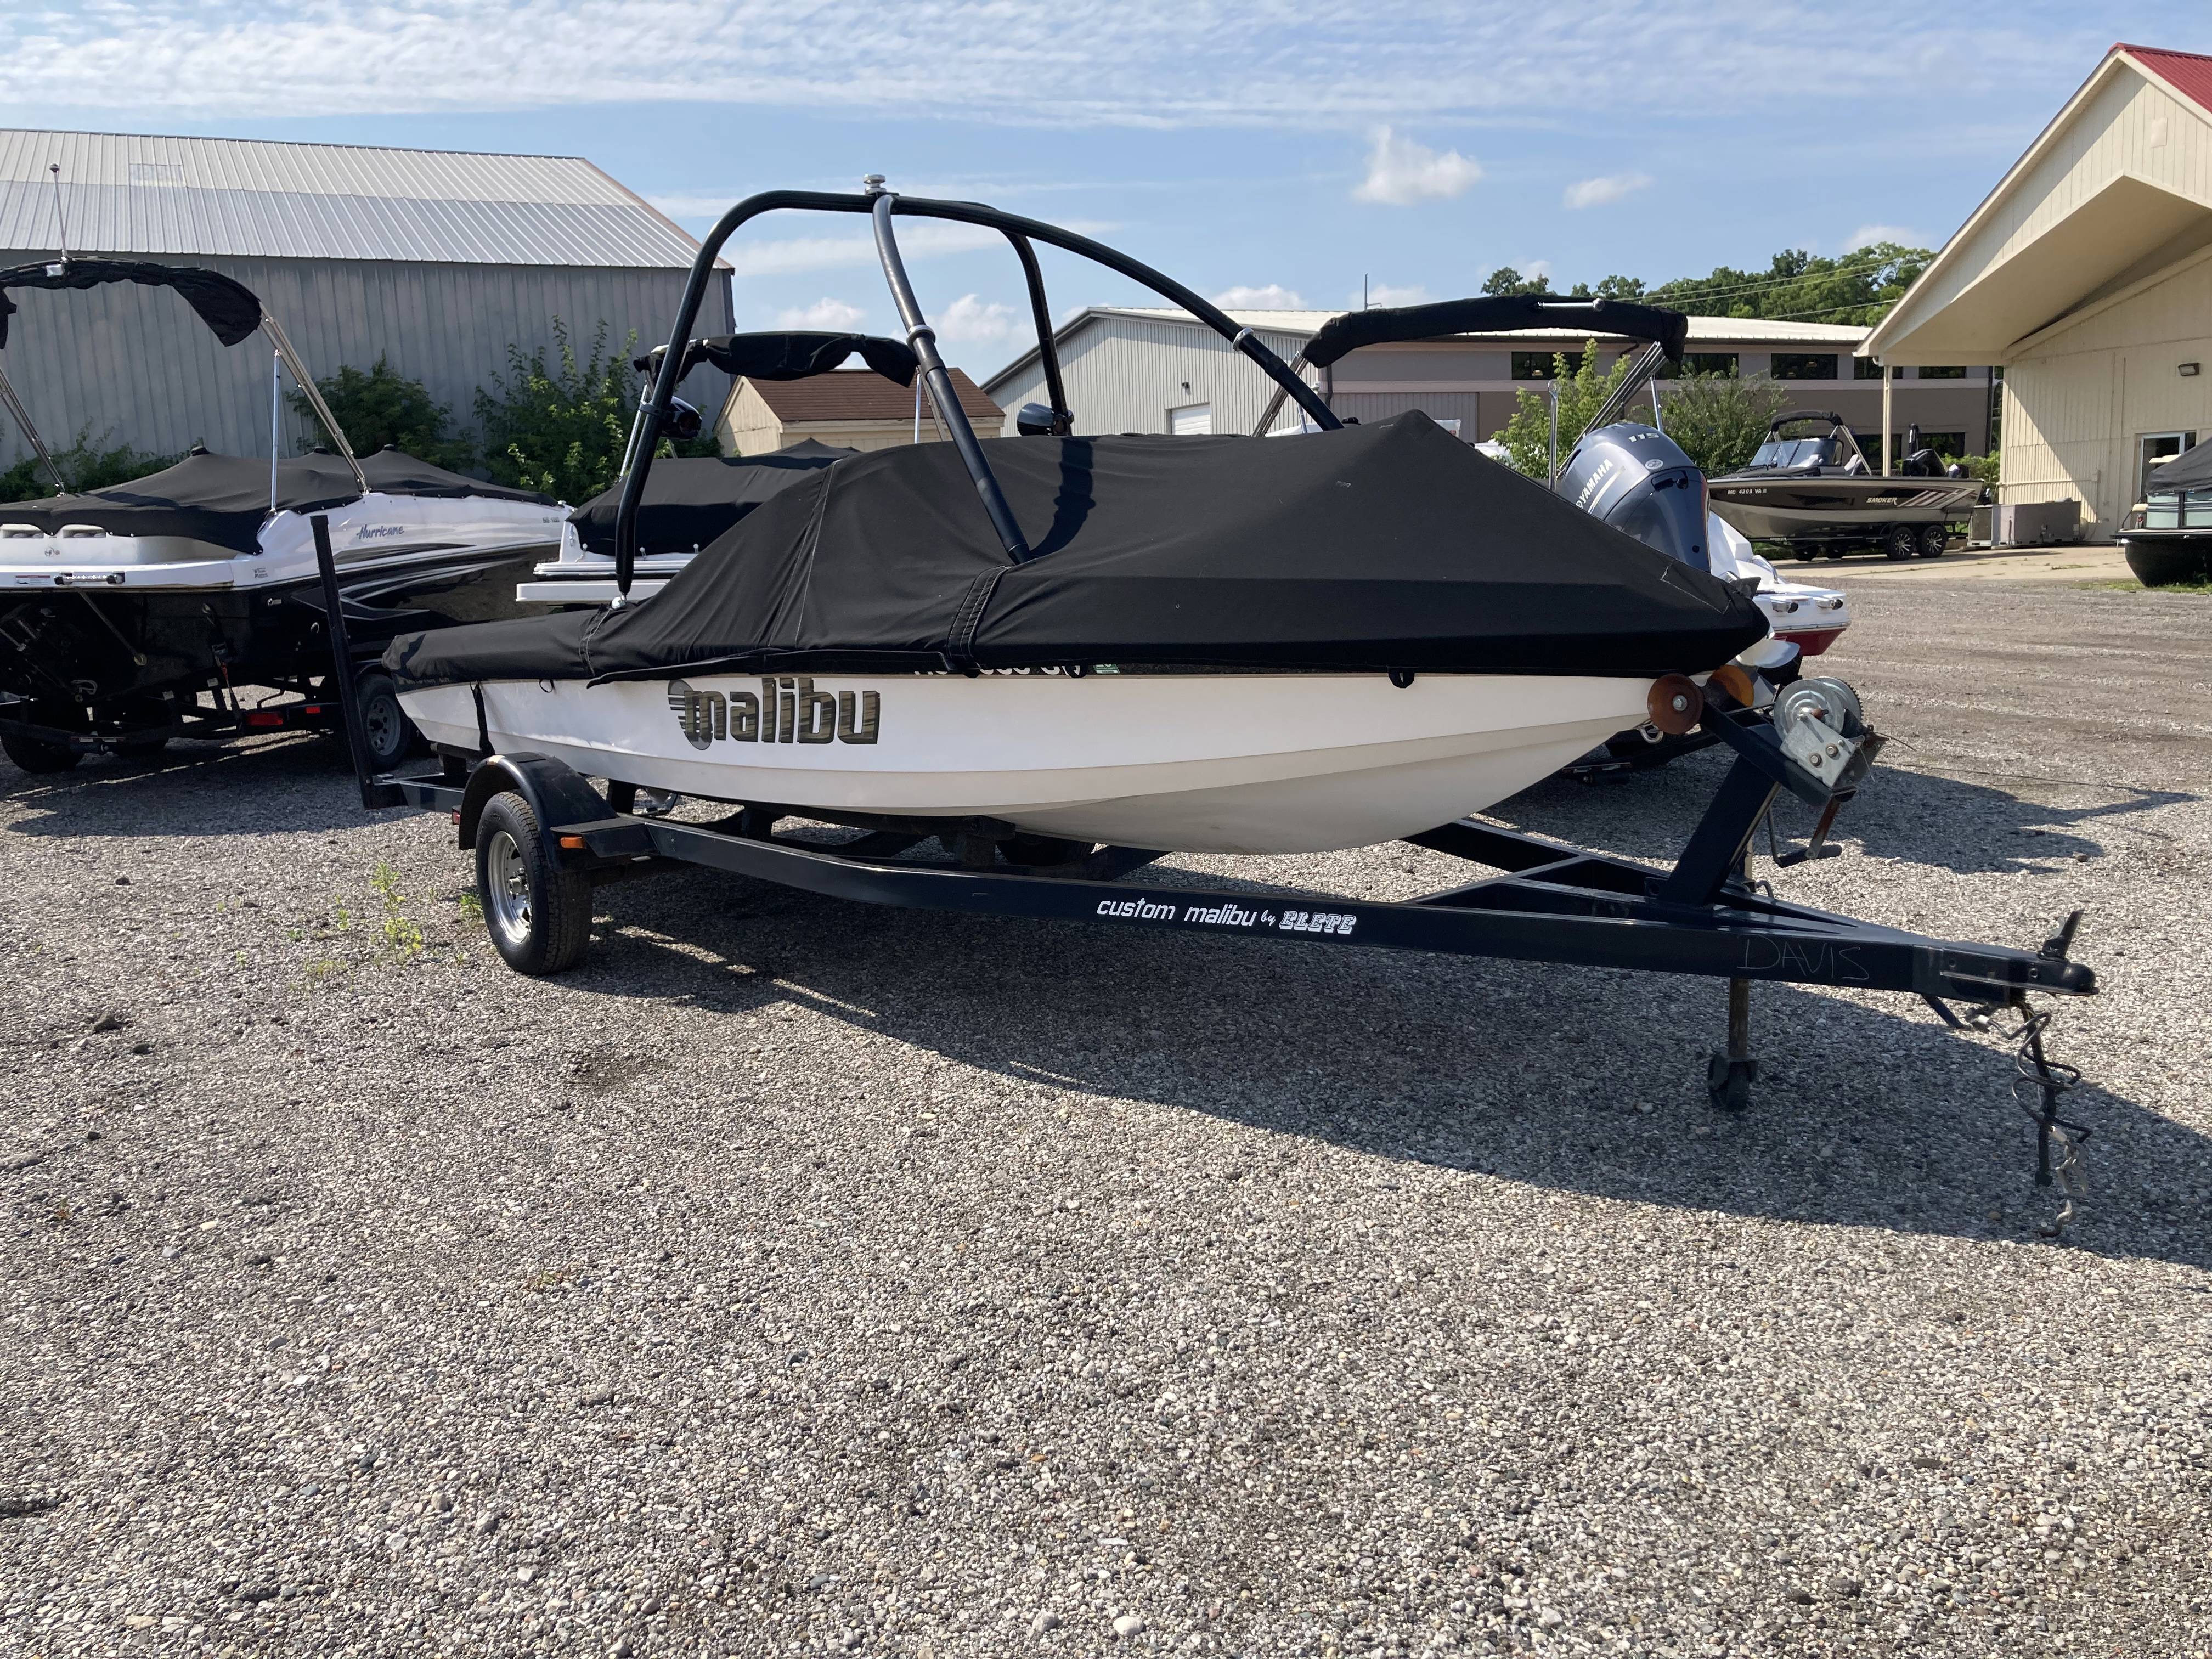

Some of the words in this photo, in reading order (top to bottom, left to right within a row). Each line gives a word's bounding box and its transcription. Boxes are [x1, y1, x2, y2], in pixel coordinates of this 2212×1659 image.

[1628, 433, 1660, 442] 115
[1579, 459, 1613, 504] YAMAHA
[1866, 497, 1897, 505] SMOKER
[356, 524, 405, 539] Hurricane
[684, 677, 881, 744] malibu
[1097, 898, 1176, 920] custom
[1184, 904, 1257, 927] malibu
[1261, 909, 1276, 926] by
[1279, 910, 1357, 934] ELETE
[1736, 934, 1870, 980] DAVIS
